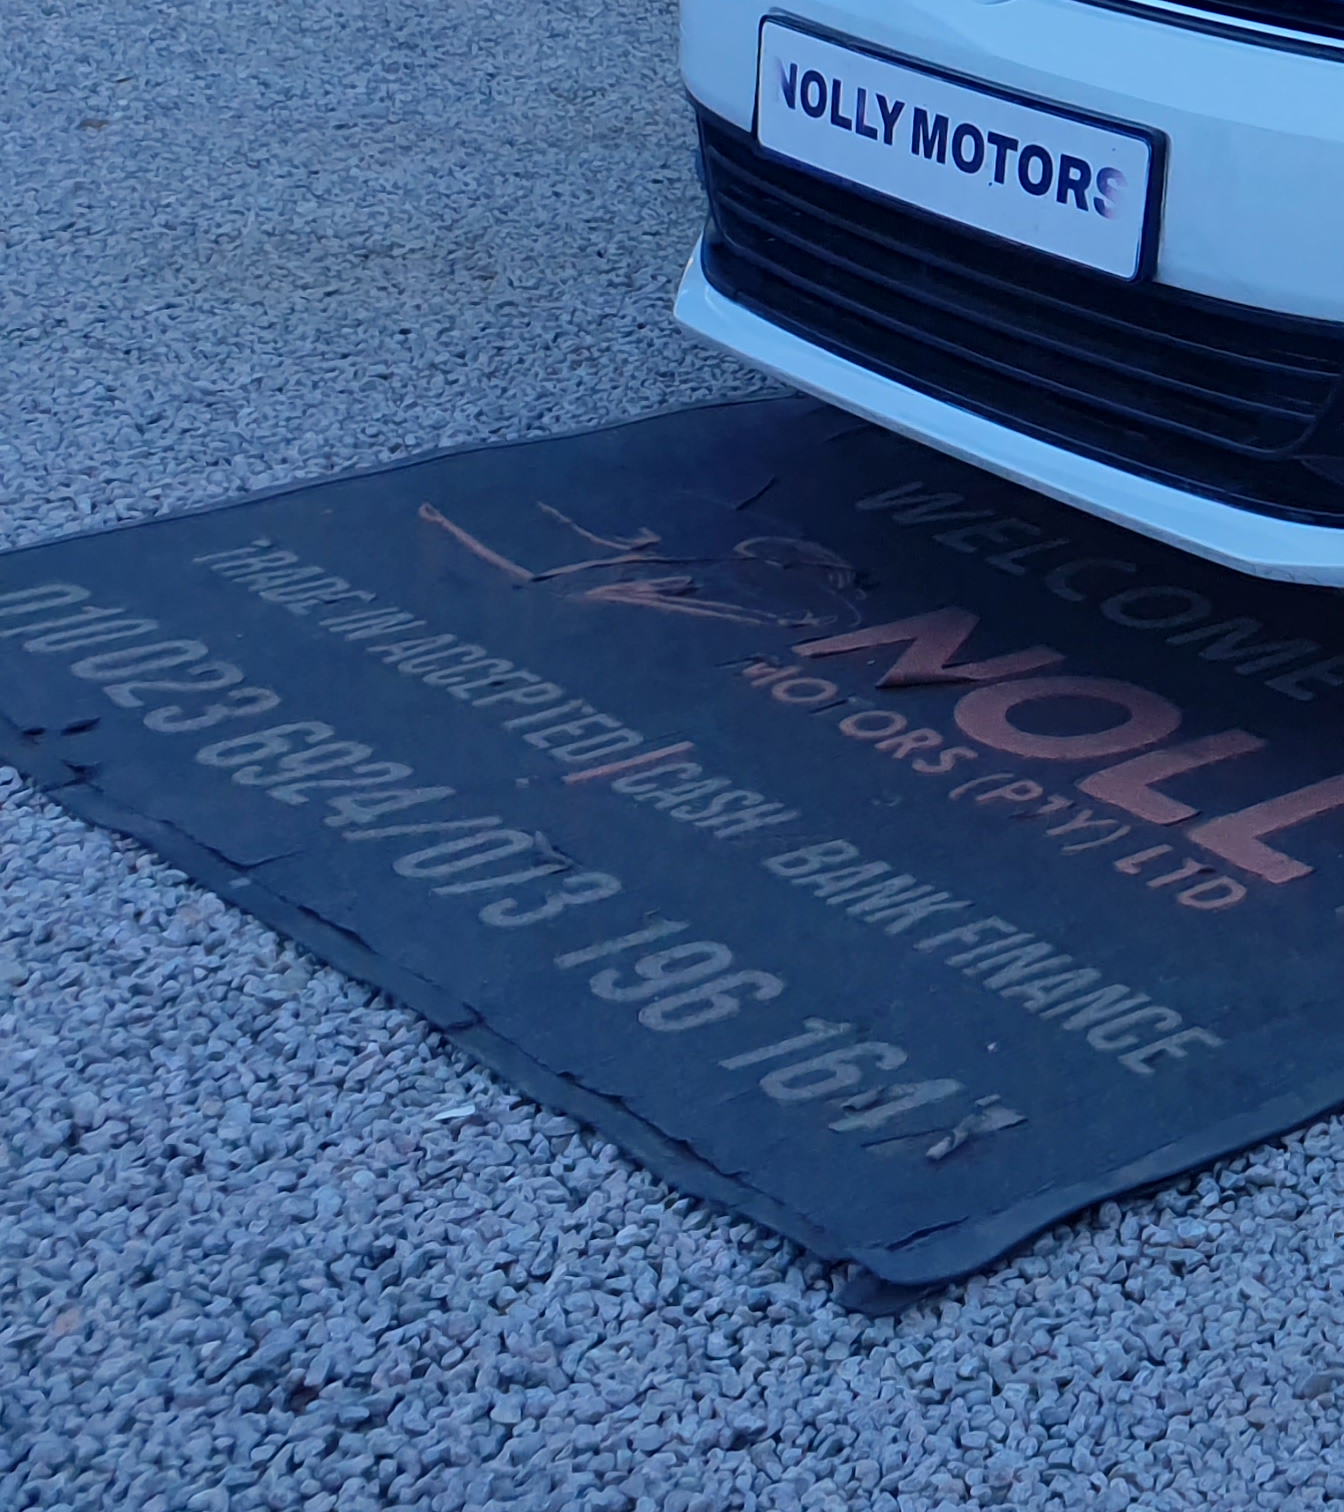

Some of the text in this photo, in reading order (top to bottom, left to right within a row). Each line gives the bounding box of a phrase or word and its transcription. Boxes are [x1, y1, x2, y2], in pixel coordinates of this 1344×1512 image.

[777, 58, 1128, 219] NOLLY MOTORS
[0, 582, 160, 656] 010
[69, 637, 283, 735] 023
[192, 538, 377, 617] TRADE
[318, 606, 429, 642] IN
[760, 837, 976, 938] BANK
[912, 914, 1228, 1078] FINANCE
[1112, 842, 1248, 911] LTD
[553, 906, 788, 1033] 196
